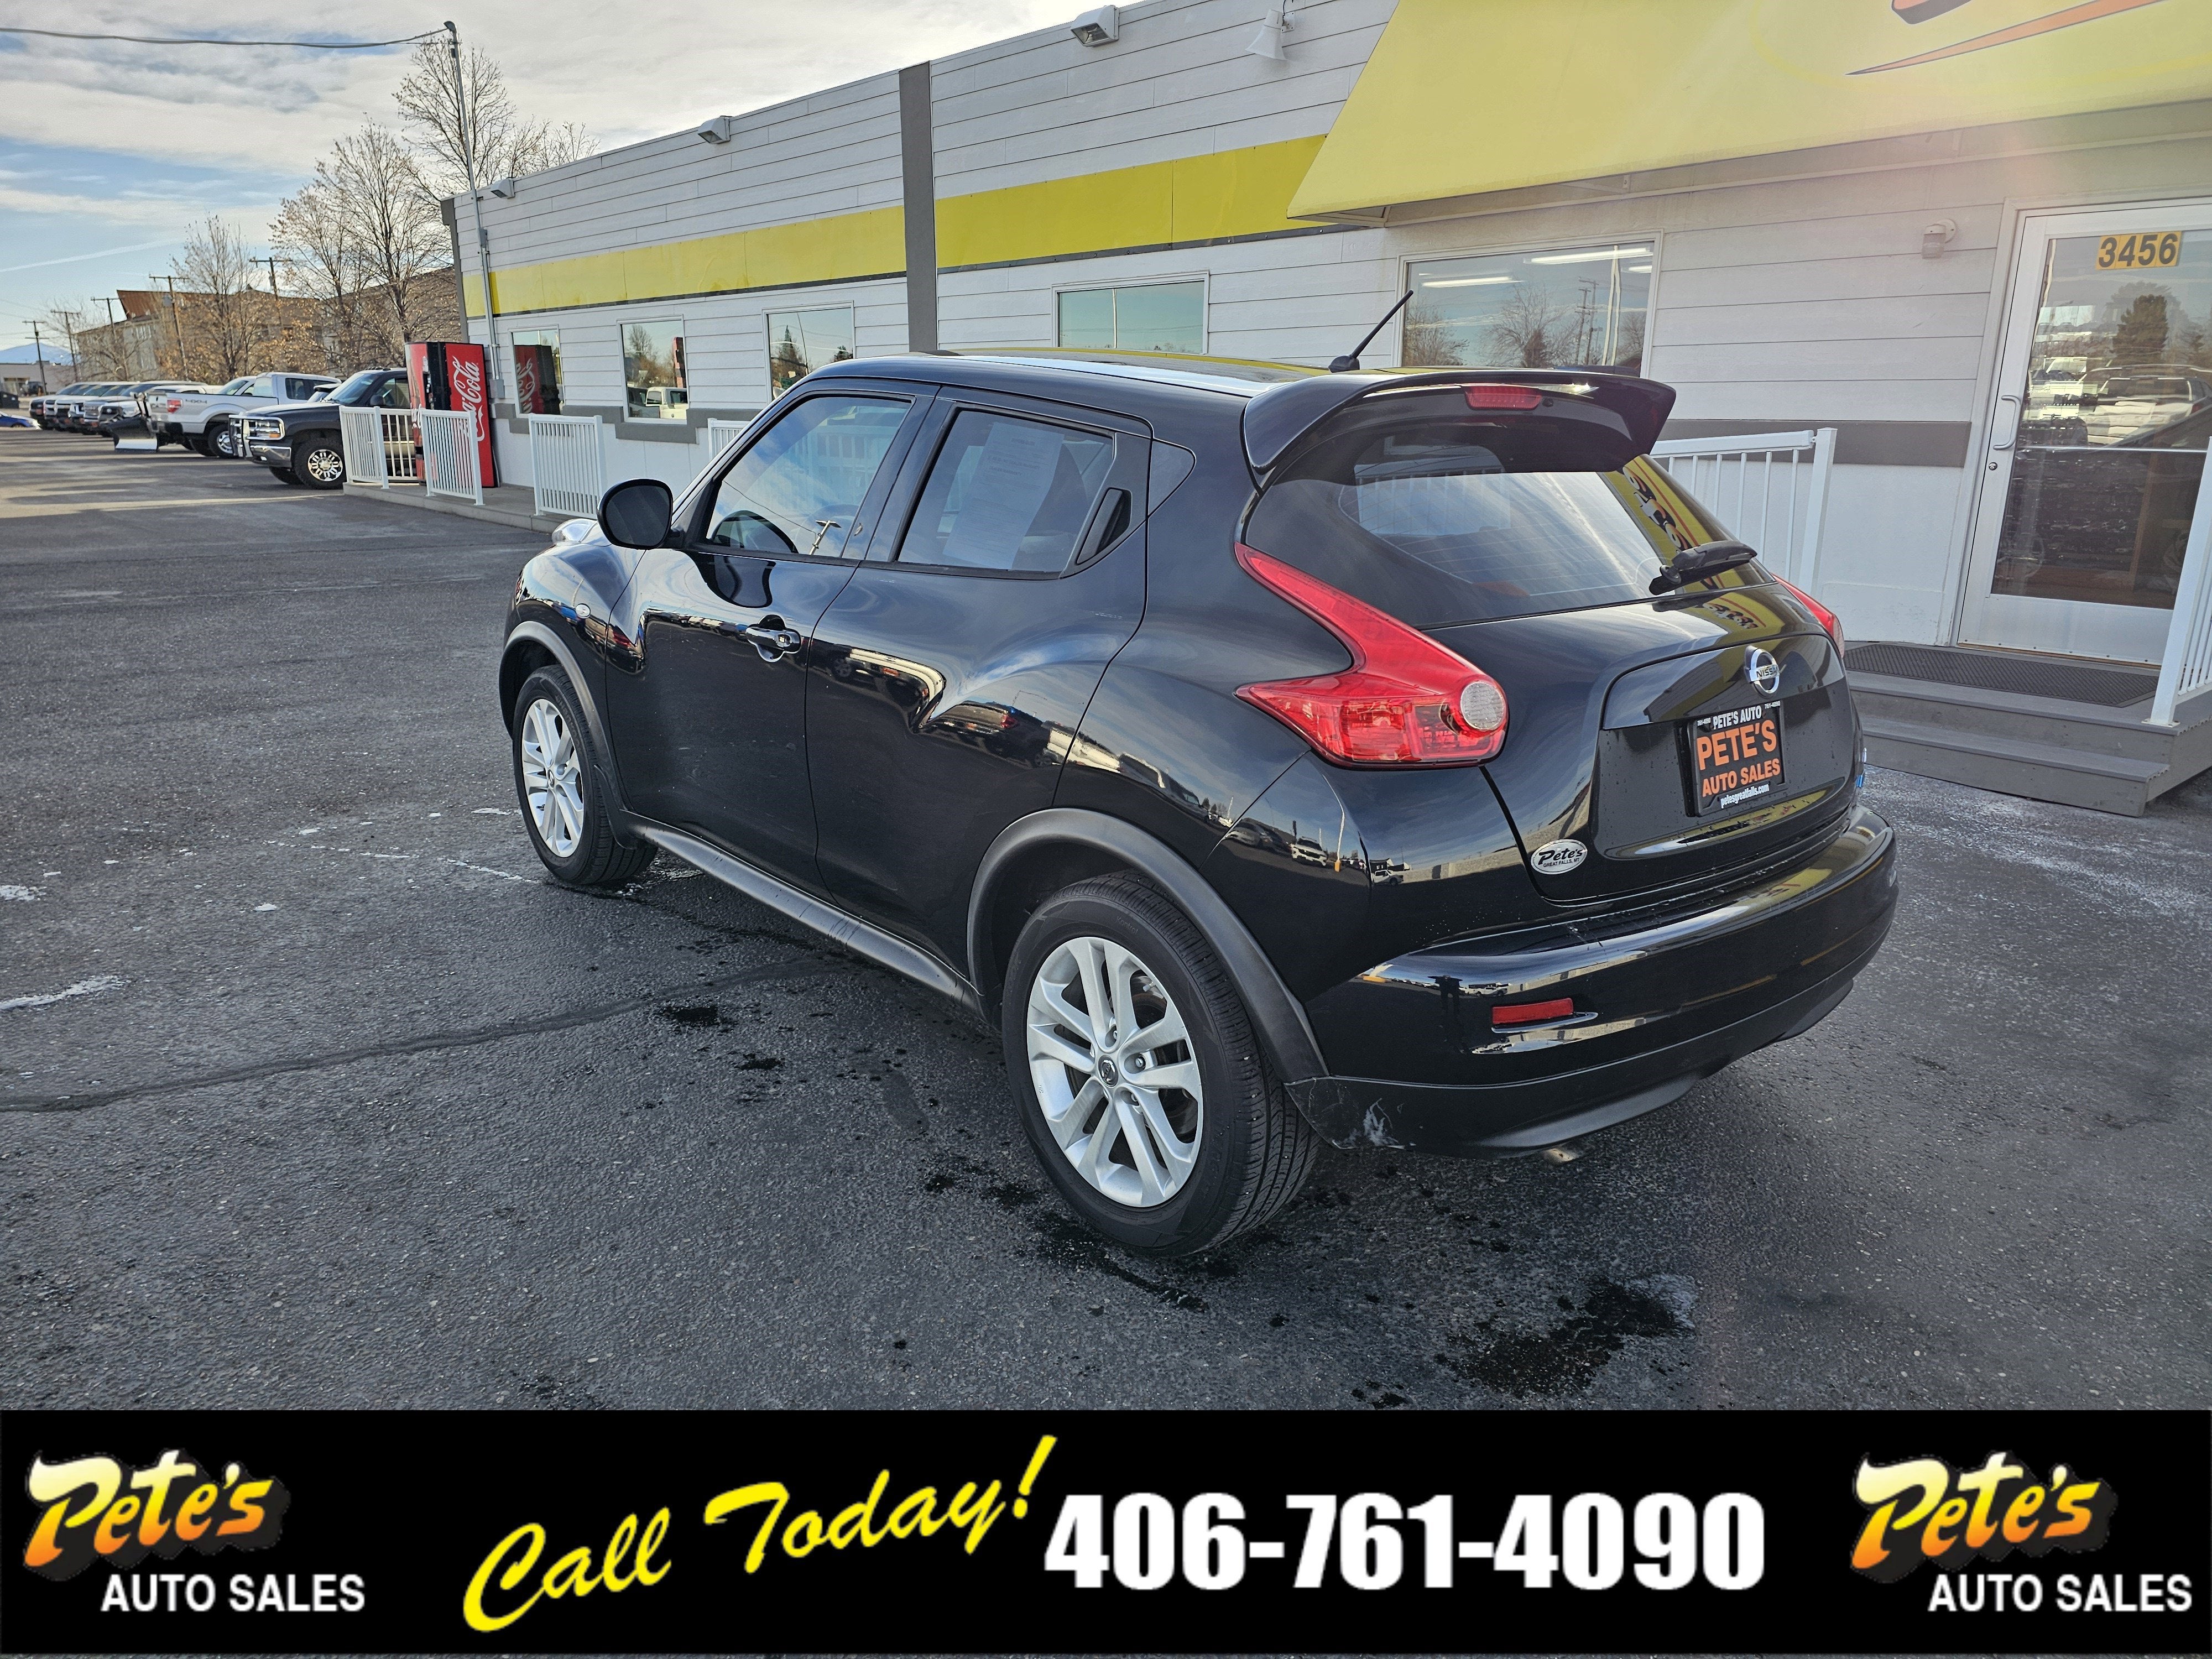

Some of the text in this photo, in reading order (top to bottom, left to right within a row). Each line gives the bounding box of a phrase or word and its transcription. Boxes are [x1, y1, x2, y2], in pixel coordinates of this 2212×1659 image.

[2099, 233, 2178, 268] 3456
[1713, 705, 1762, 730] PETE'S AUTO
[1697, 719, 1777, 771] PETE'S
[1702, 758, 1781, 797] AUTO SALES
[1720, 783, 1770, 809] petesgreatfalls.com
[1538, 848, 1583, 865] Pete's
